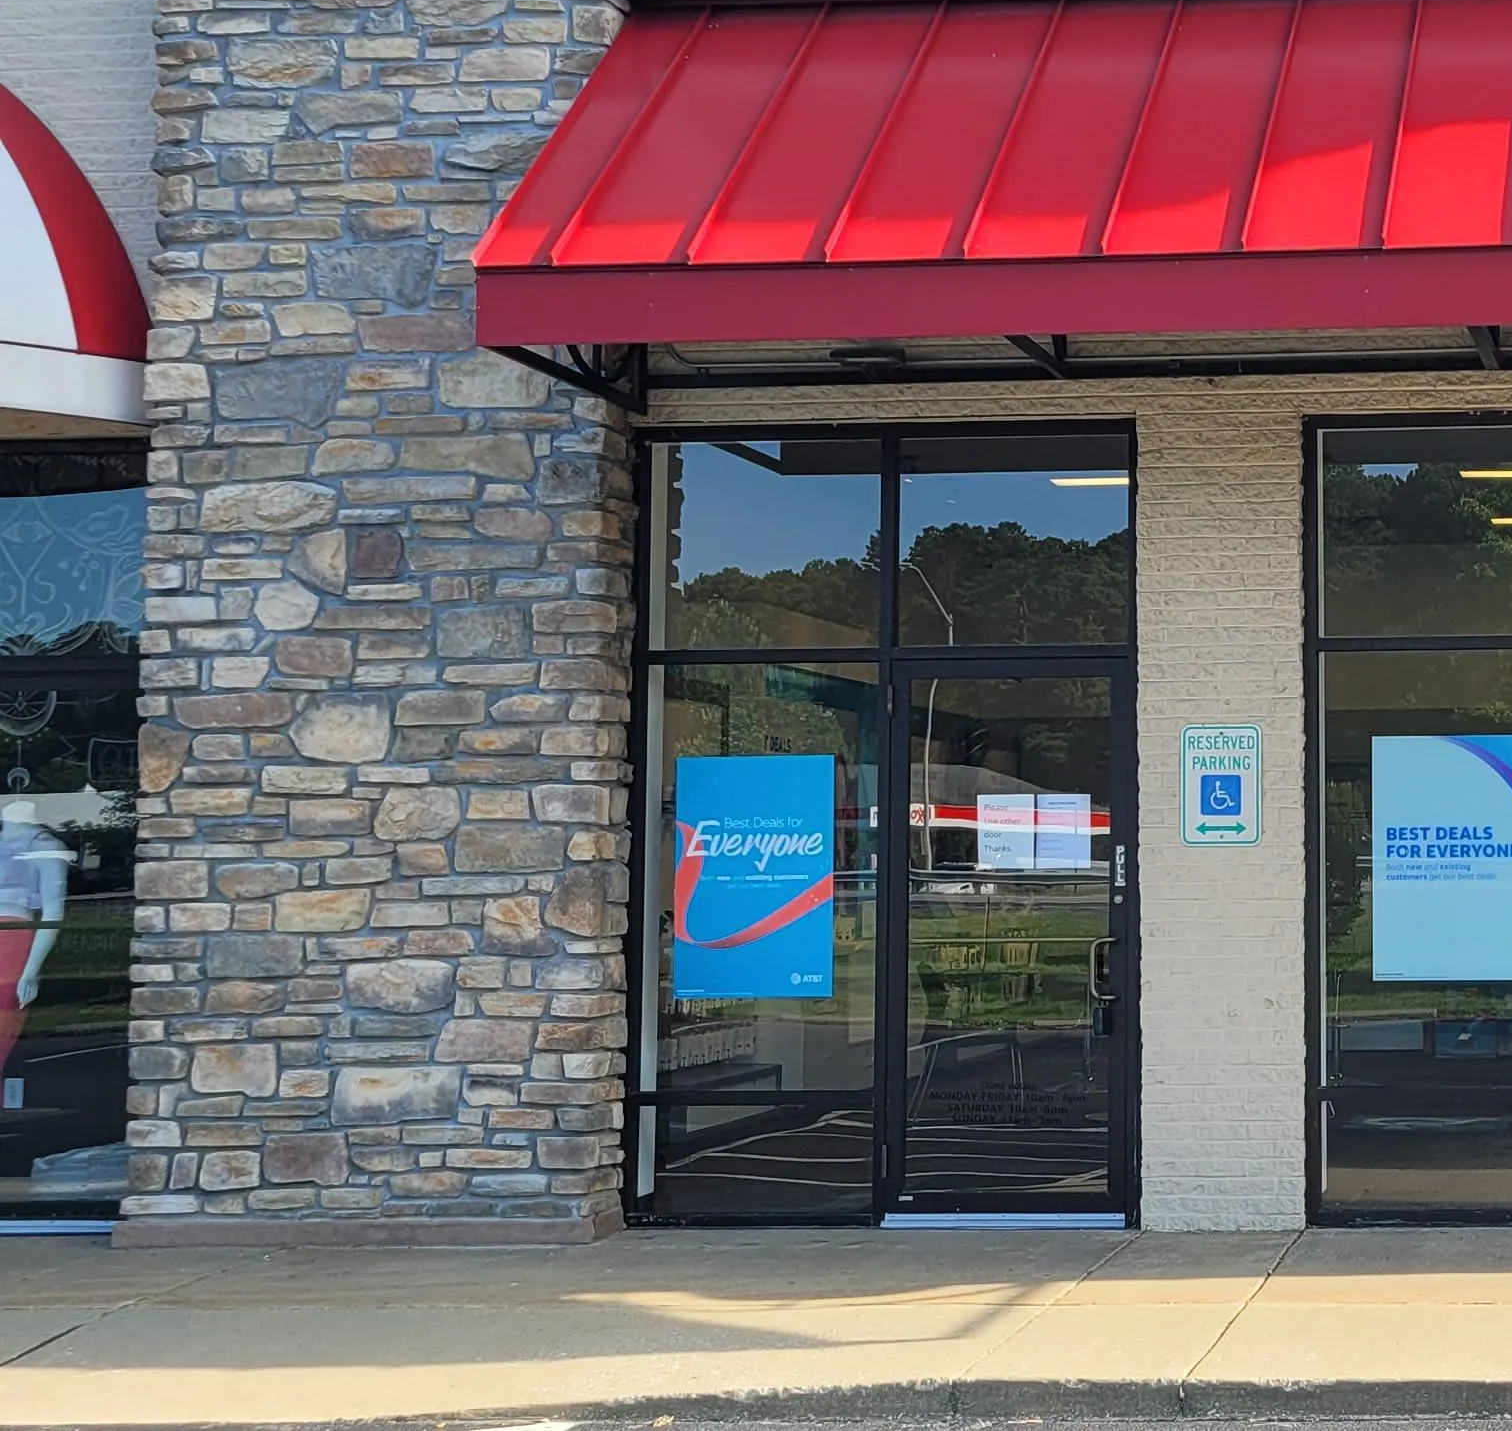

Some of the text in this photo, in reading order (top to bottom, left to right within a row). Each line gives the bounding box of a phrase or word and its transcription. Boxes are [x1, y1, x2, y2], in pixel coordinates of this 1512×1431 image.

[1187, 735, 1256, 750] RESERVED
[1192, 756, 1251, 770] PARKING
[724, 815, 804, 829] Best Deals for
[983, 830, 1002, 839] door
[1386, 826, 1493, 841] BEST DEALS
[686, 820, 824, 873] Everyone
[1386, 844, 1421, 859] FOR
[1115, 845, 1125, 882] PULL
[1386, 873, 1428, 881] customers
